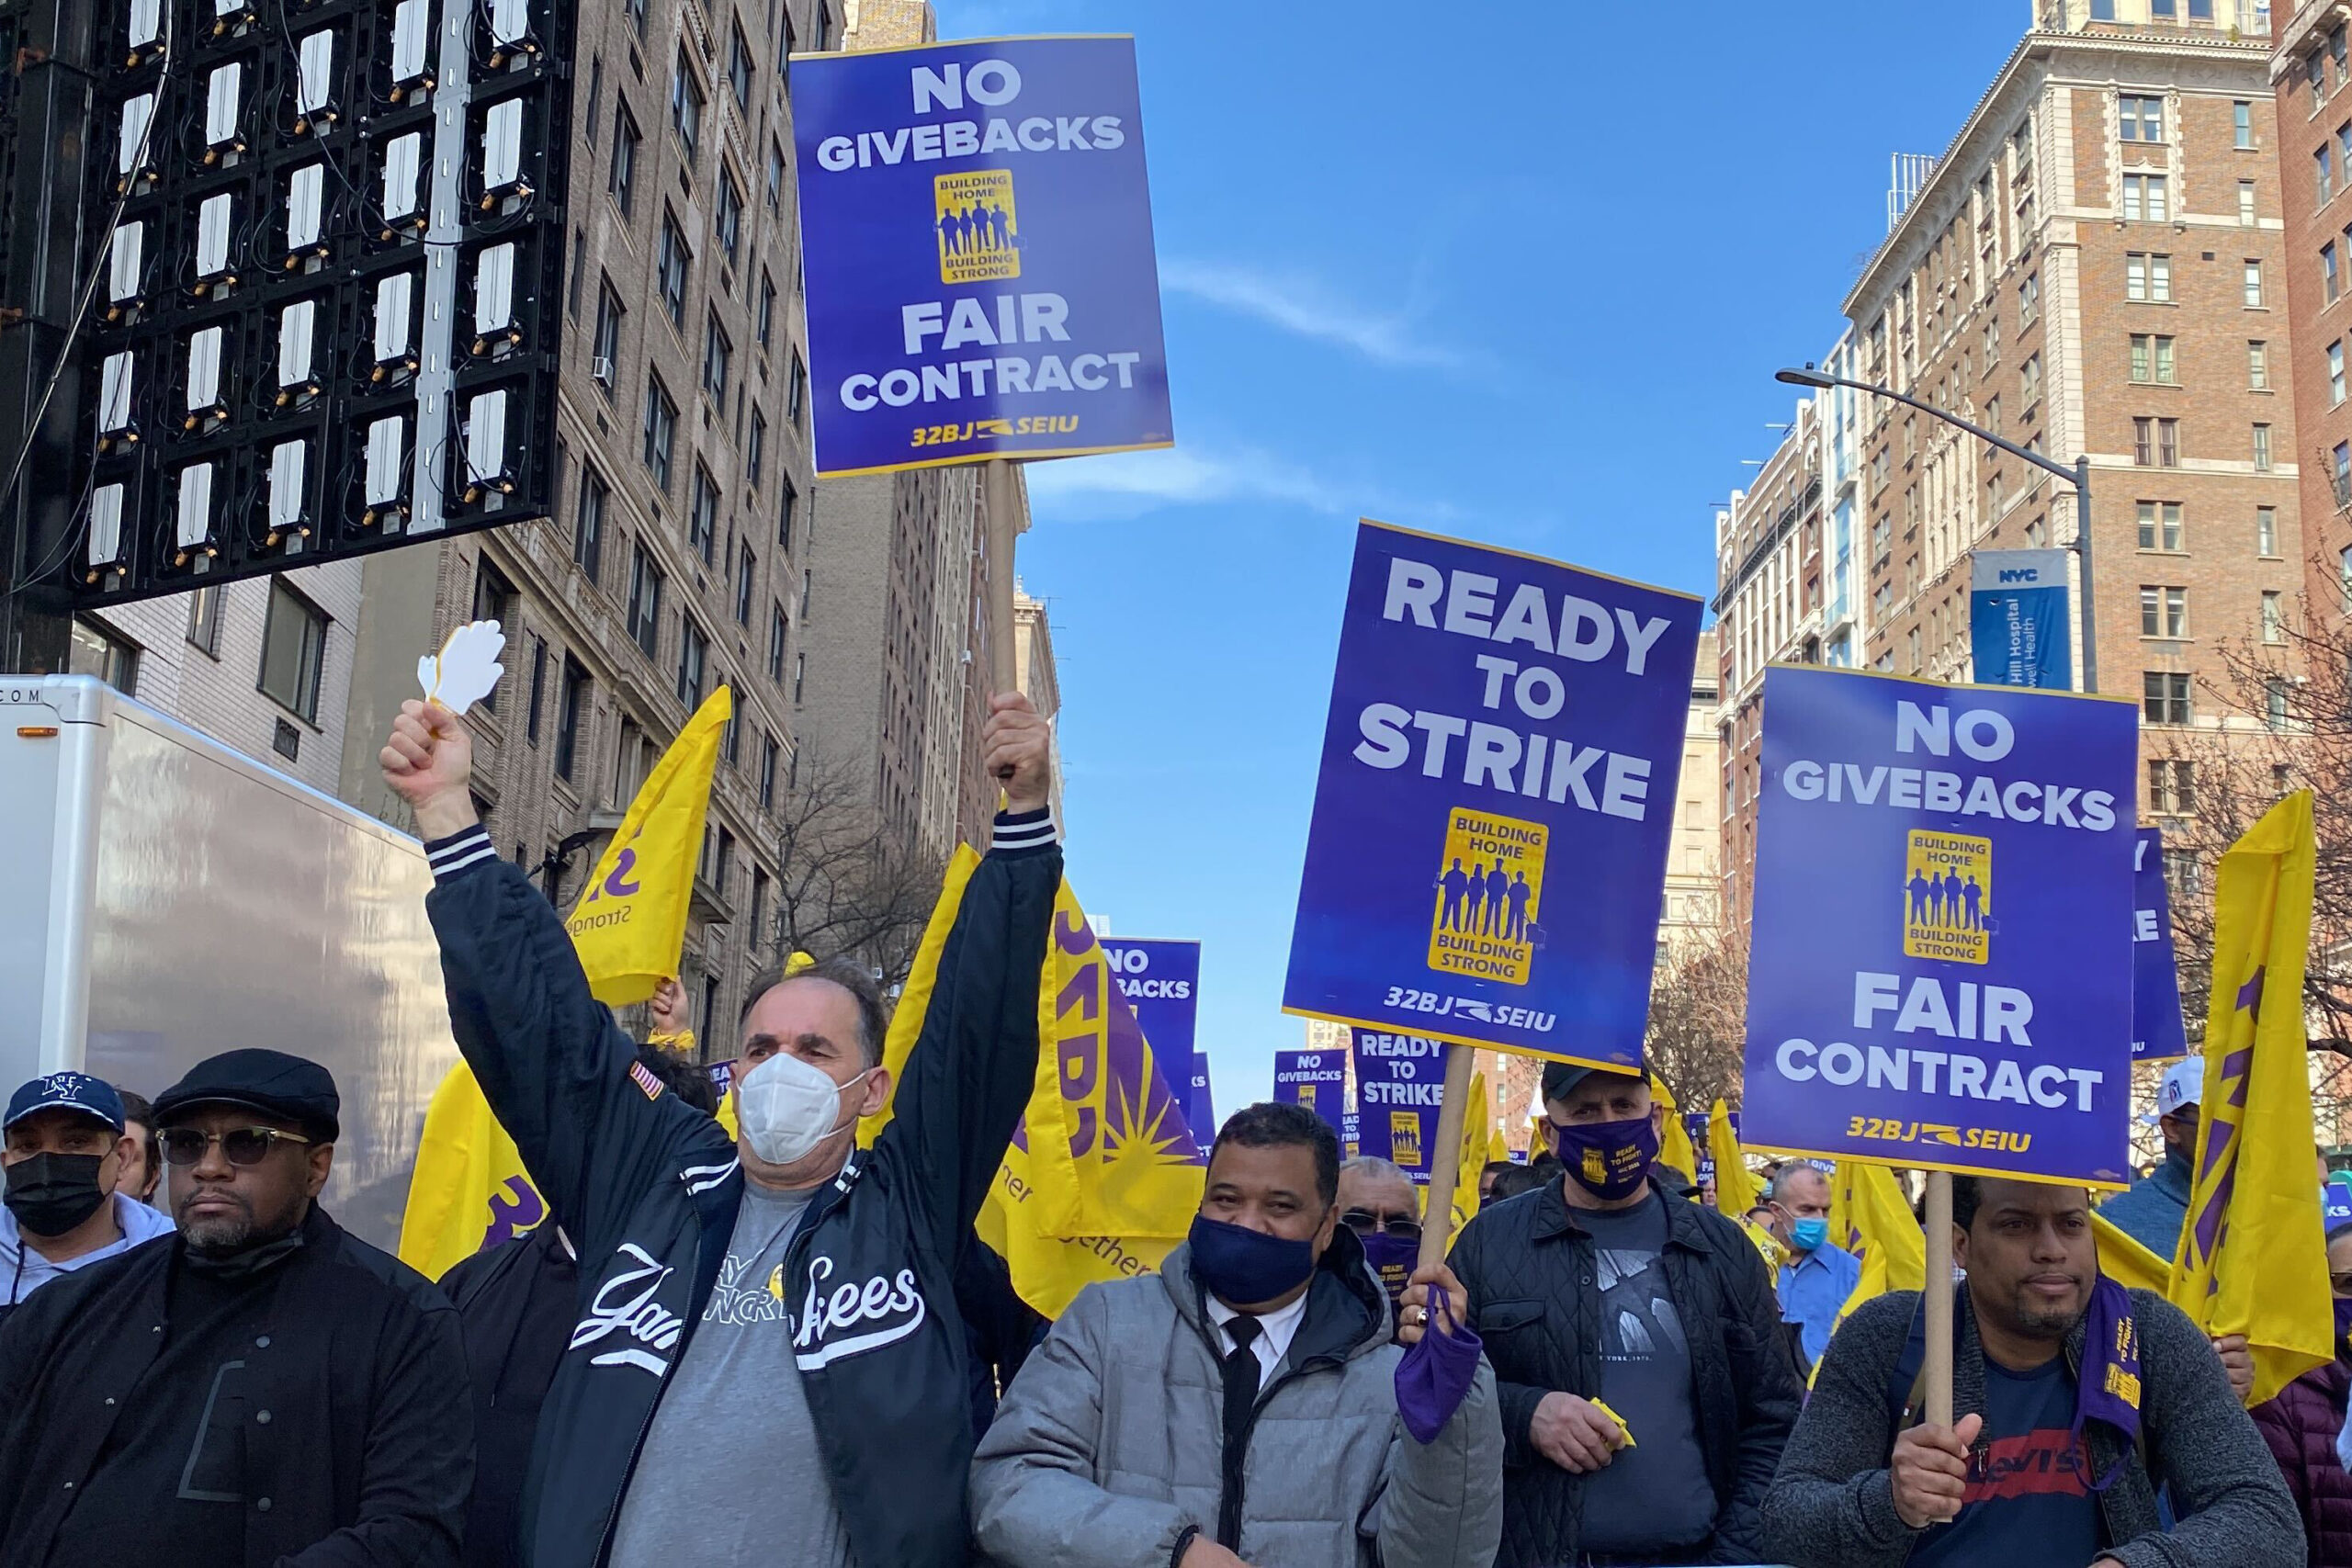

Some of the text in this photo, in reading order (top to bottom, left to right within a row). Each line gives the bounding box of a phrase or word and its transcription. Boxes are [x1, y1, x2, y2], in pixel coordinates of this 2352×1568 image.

[911, 60, 1022, 115] NO
[817, 116, 1125, 173] GIVEBACKS
[940, 175, 1008, 191] BUILDING
[953, 187, 996, 200] HOME
[945, 253, 1013, 269] BUILDING
[951, 265, 1010, 280] STRONG
[901, 292, 1071, 355] FAIR
[840, 352, 1140, 412] CONTRACT
[910, 415, 1080, 447] 32BJ SEIU
[1999, 569, 2038, 583] NYC
[1383, 557, 1672, 676] READY
[2007, 598, 2022, 683] Hill Hospital
[2023, 617, 2035, 660] Health
[1476, 654, 1565, 721] TO
[1895, 700, 2015, 762] NO
[1351, 702, 1652, 821] STRIKE
[1782, 760, 2116, 831] GIVEBACKS
[1454, 817, 1542, 846] BUILDING
[1914, 836, 1986, 855] BUILDING
[1469, 837, 1525, 860] HOME
[1927, 852, 1973, 867] HOME
[1437, 933, 1525, 963] BUILDING
[1910, 928, 1983, 947] BUILDING
[1914, 942, 1977, 960] STRONG
[1103, 948, 1149, 974] NO
[1441, 953, 1516, 979] STRONG
[1384, 986, 1556, 1032] 32BJ SEIU
[1853, 971, 2033, 1047] FAIR
[1362, 1034, 1443, 1058] READY
[1278, 1070, 1341, 1083] GIVEBACKS
[1297, 1055, 1321, 1069] NO
[1388, 1061, 1416, 1079] TO
[1776, 1038, 2103, 1112] CONTRACT
[1364, 1082, 1445, 1106] STRIKE
[1847, 1117, 2031, 1153] 32BJ SEIU
